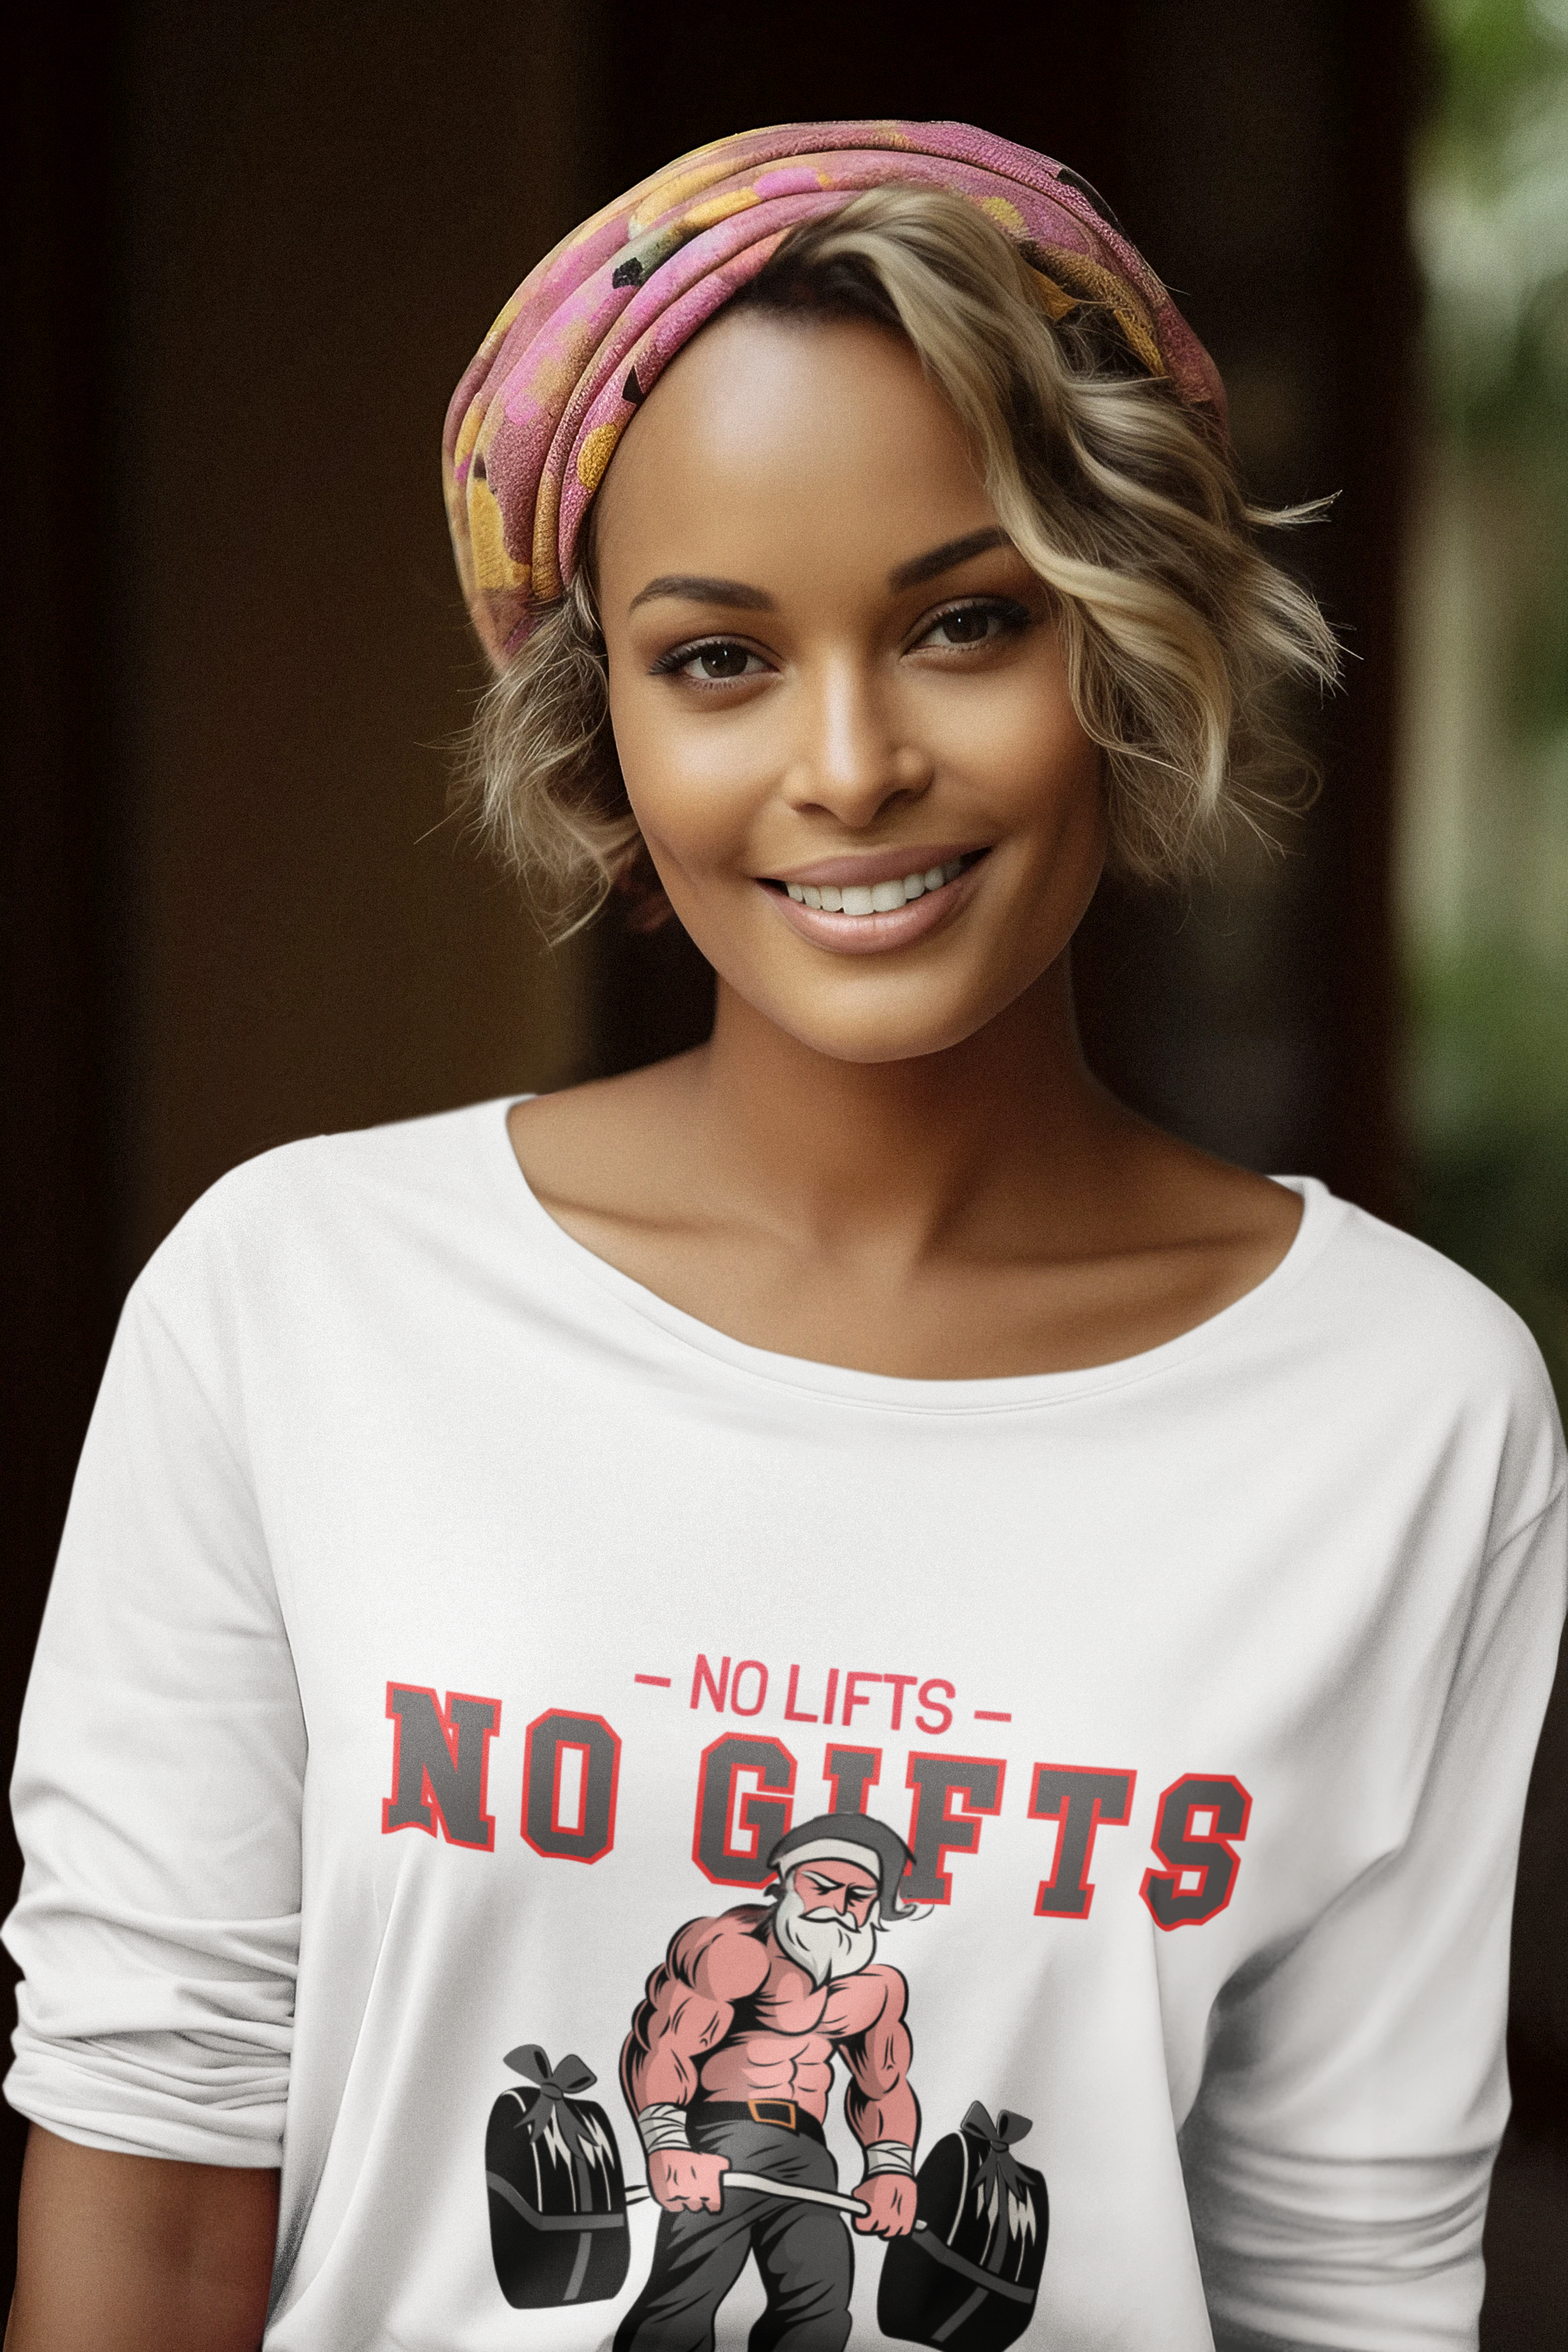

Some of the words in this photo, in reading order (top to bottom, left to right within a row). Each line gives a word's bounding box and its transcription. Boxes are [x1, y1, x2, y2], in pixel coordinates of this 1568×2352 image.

[691, 1653, 769, 1717] NO
[783, 1664, 956, 1735] LIFTS
[381, 1681, 623, 1865] NO
